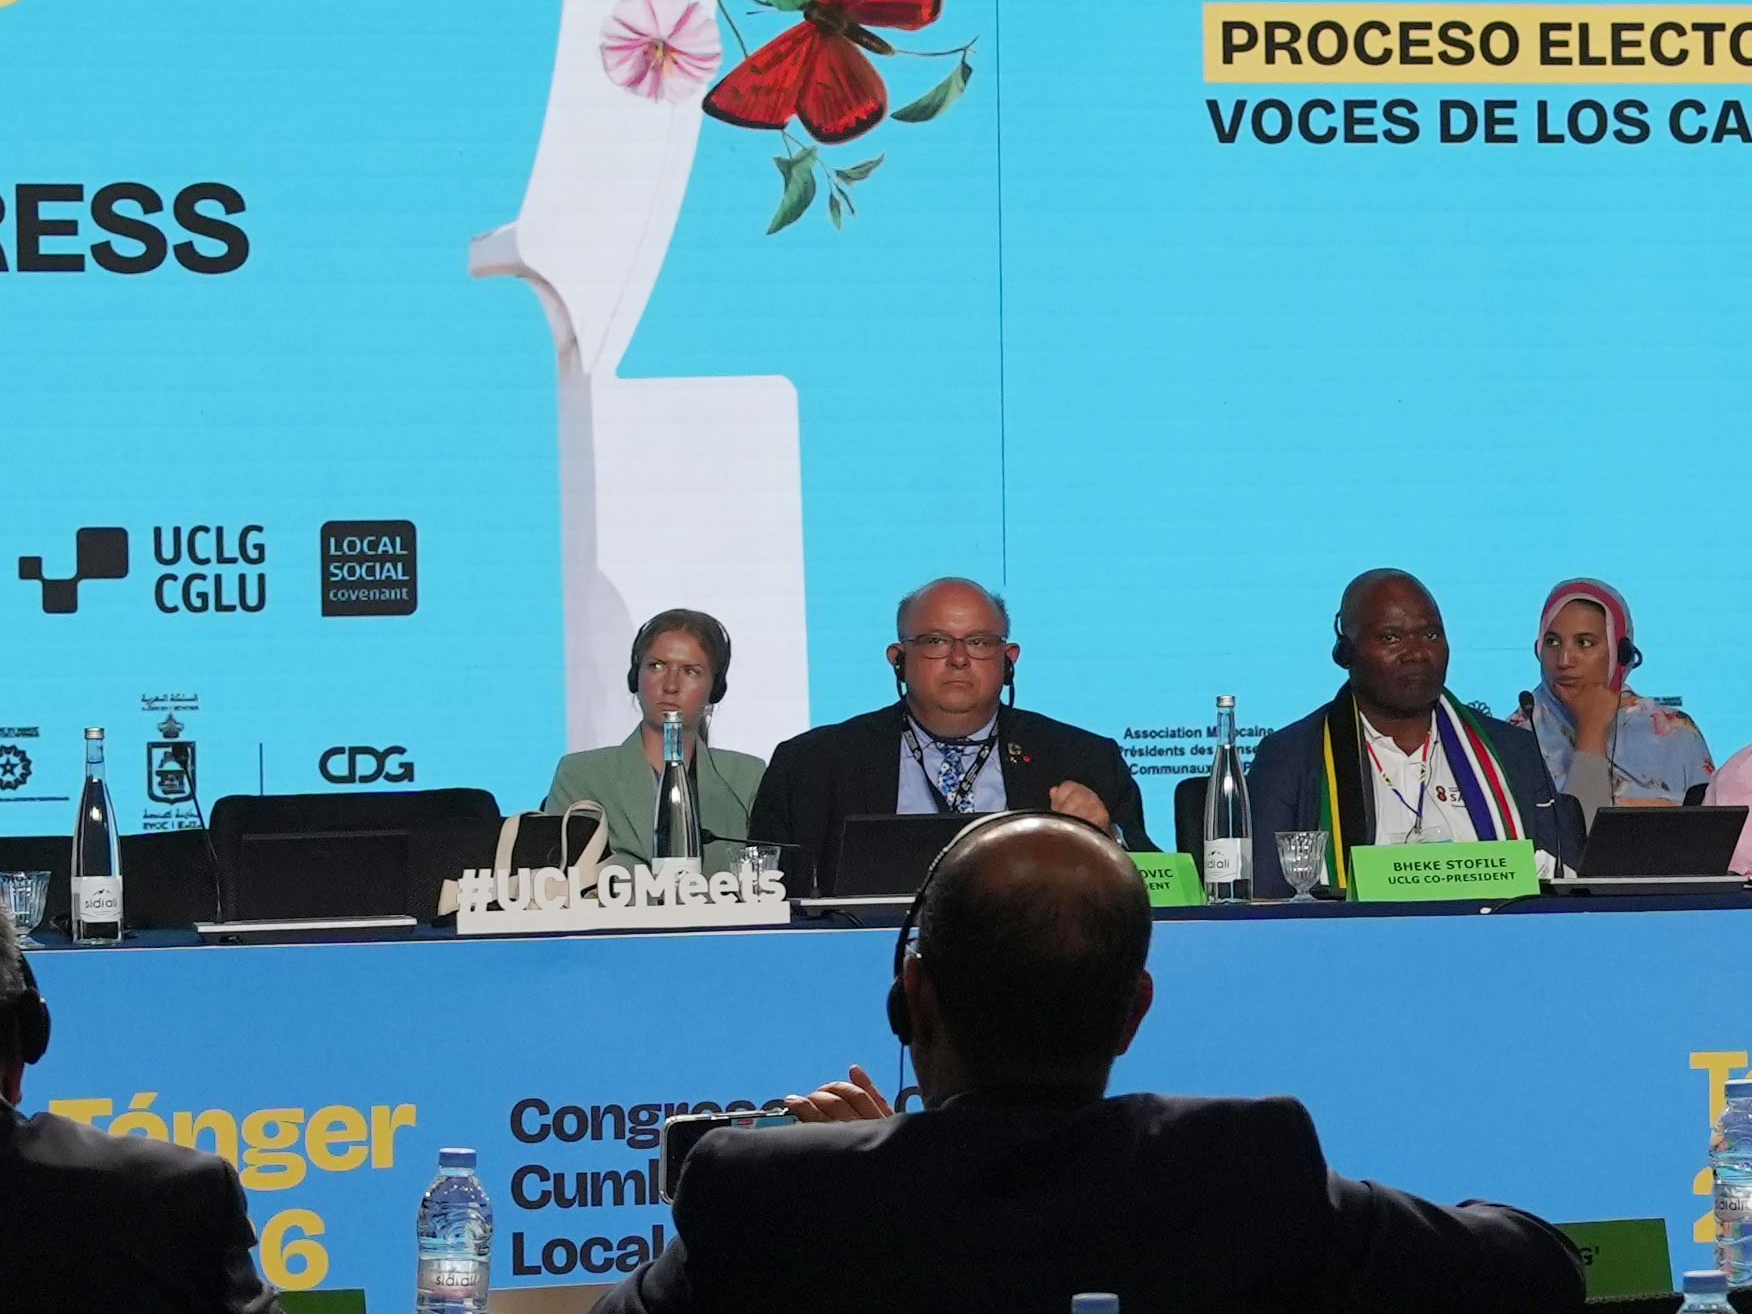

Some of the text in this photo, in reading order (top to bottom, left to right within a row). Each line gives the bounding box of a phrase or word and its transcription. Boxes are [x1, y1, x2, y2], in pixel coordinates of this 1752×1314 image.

[1219, 20, 1520, 67] PROCESO
[1205, 97, 1422, 145] VOCES
[1437, 98, 1519, 145] DE
[1536, 98, 1651, 145] LOS
[153, 525, 266, 566] UCLG
[329, 535, 408, 555] LOCAL
[329, 562, 409, 581] SOCIAL
[154, 573, 267, 613] CGLU
[329, 586, 409, 602] covenant
[1124, 726, 1202, 739] Association
[1191, 744, 1213, 756] des
[318, 745, 415, 784] CDG
[1394, 857, 1507, 872] BHEKE STOFILE
[1388, 871, 1516, 885] UCLG CO-PRESIDENT
[457, 865, 787, 917] #UCLGMeets
